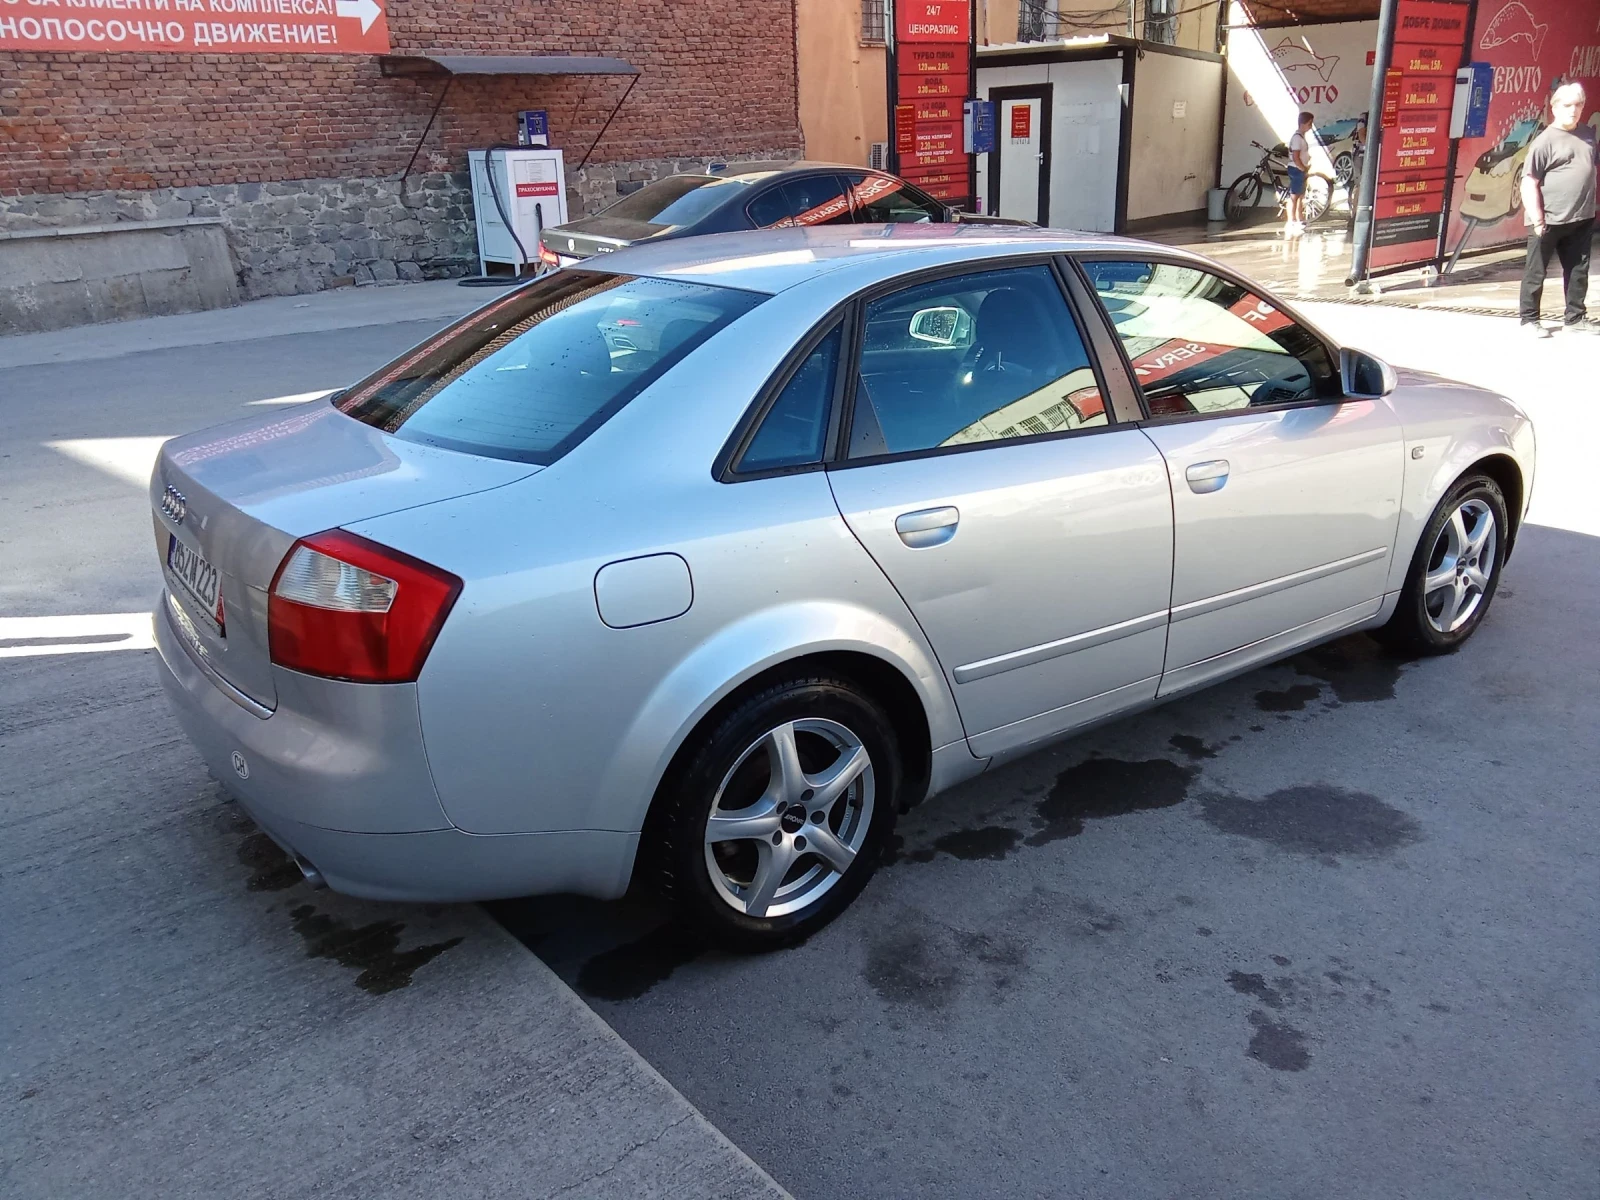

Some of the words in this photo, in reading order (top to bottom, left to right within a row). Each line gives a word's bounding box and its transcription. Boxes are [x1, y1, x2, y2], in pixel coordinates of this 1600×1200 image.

[210, 0, 333, 14] КОМПЛЕКСА!
[926, 5, 940, 15] 24/7
[1402, 16, 1430, 29] ДОБРЕ
[0, 17, 184, 42] НОПОСОЧНО
[194, 22, 338, 46] ДВИЖЕНИЕ!
[908, 24, 958, 35] ЦЕНОРАЗПИС
[912, 52, 934, 60] ТУРБО
